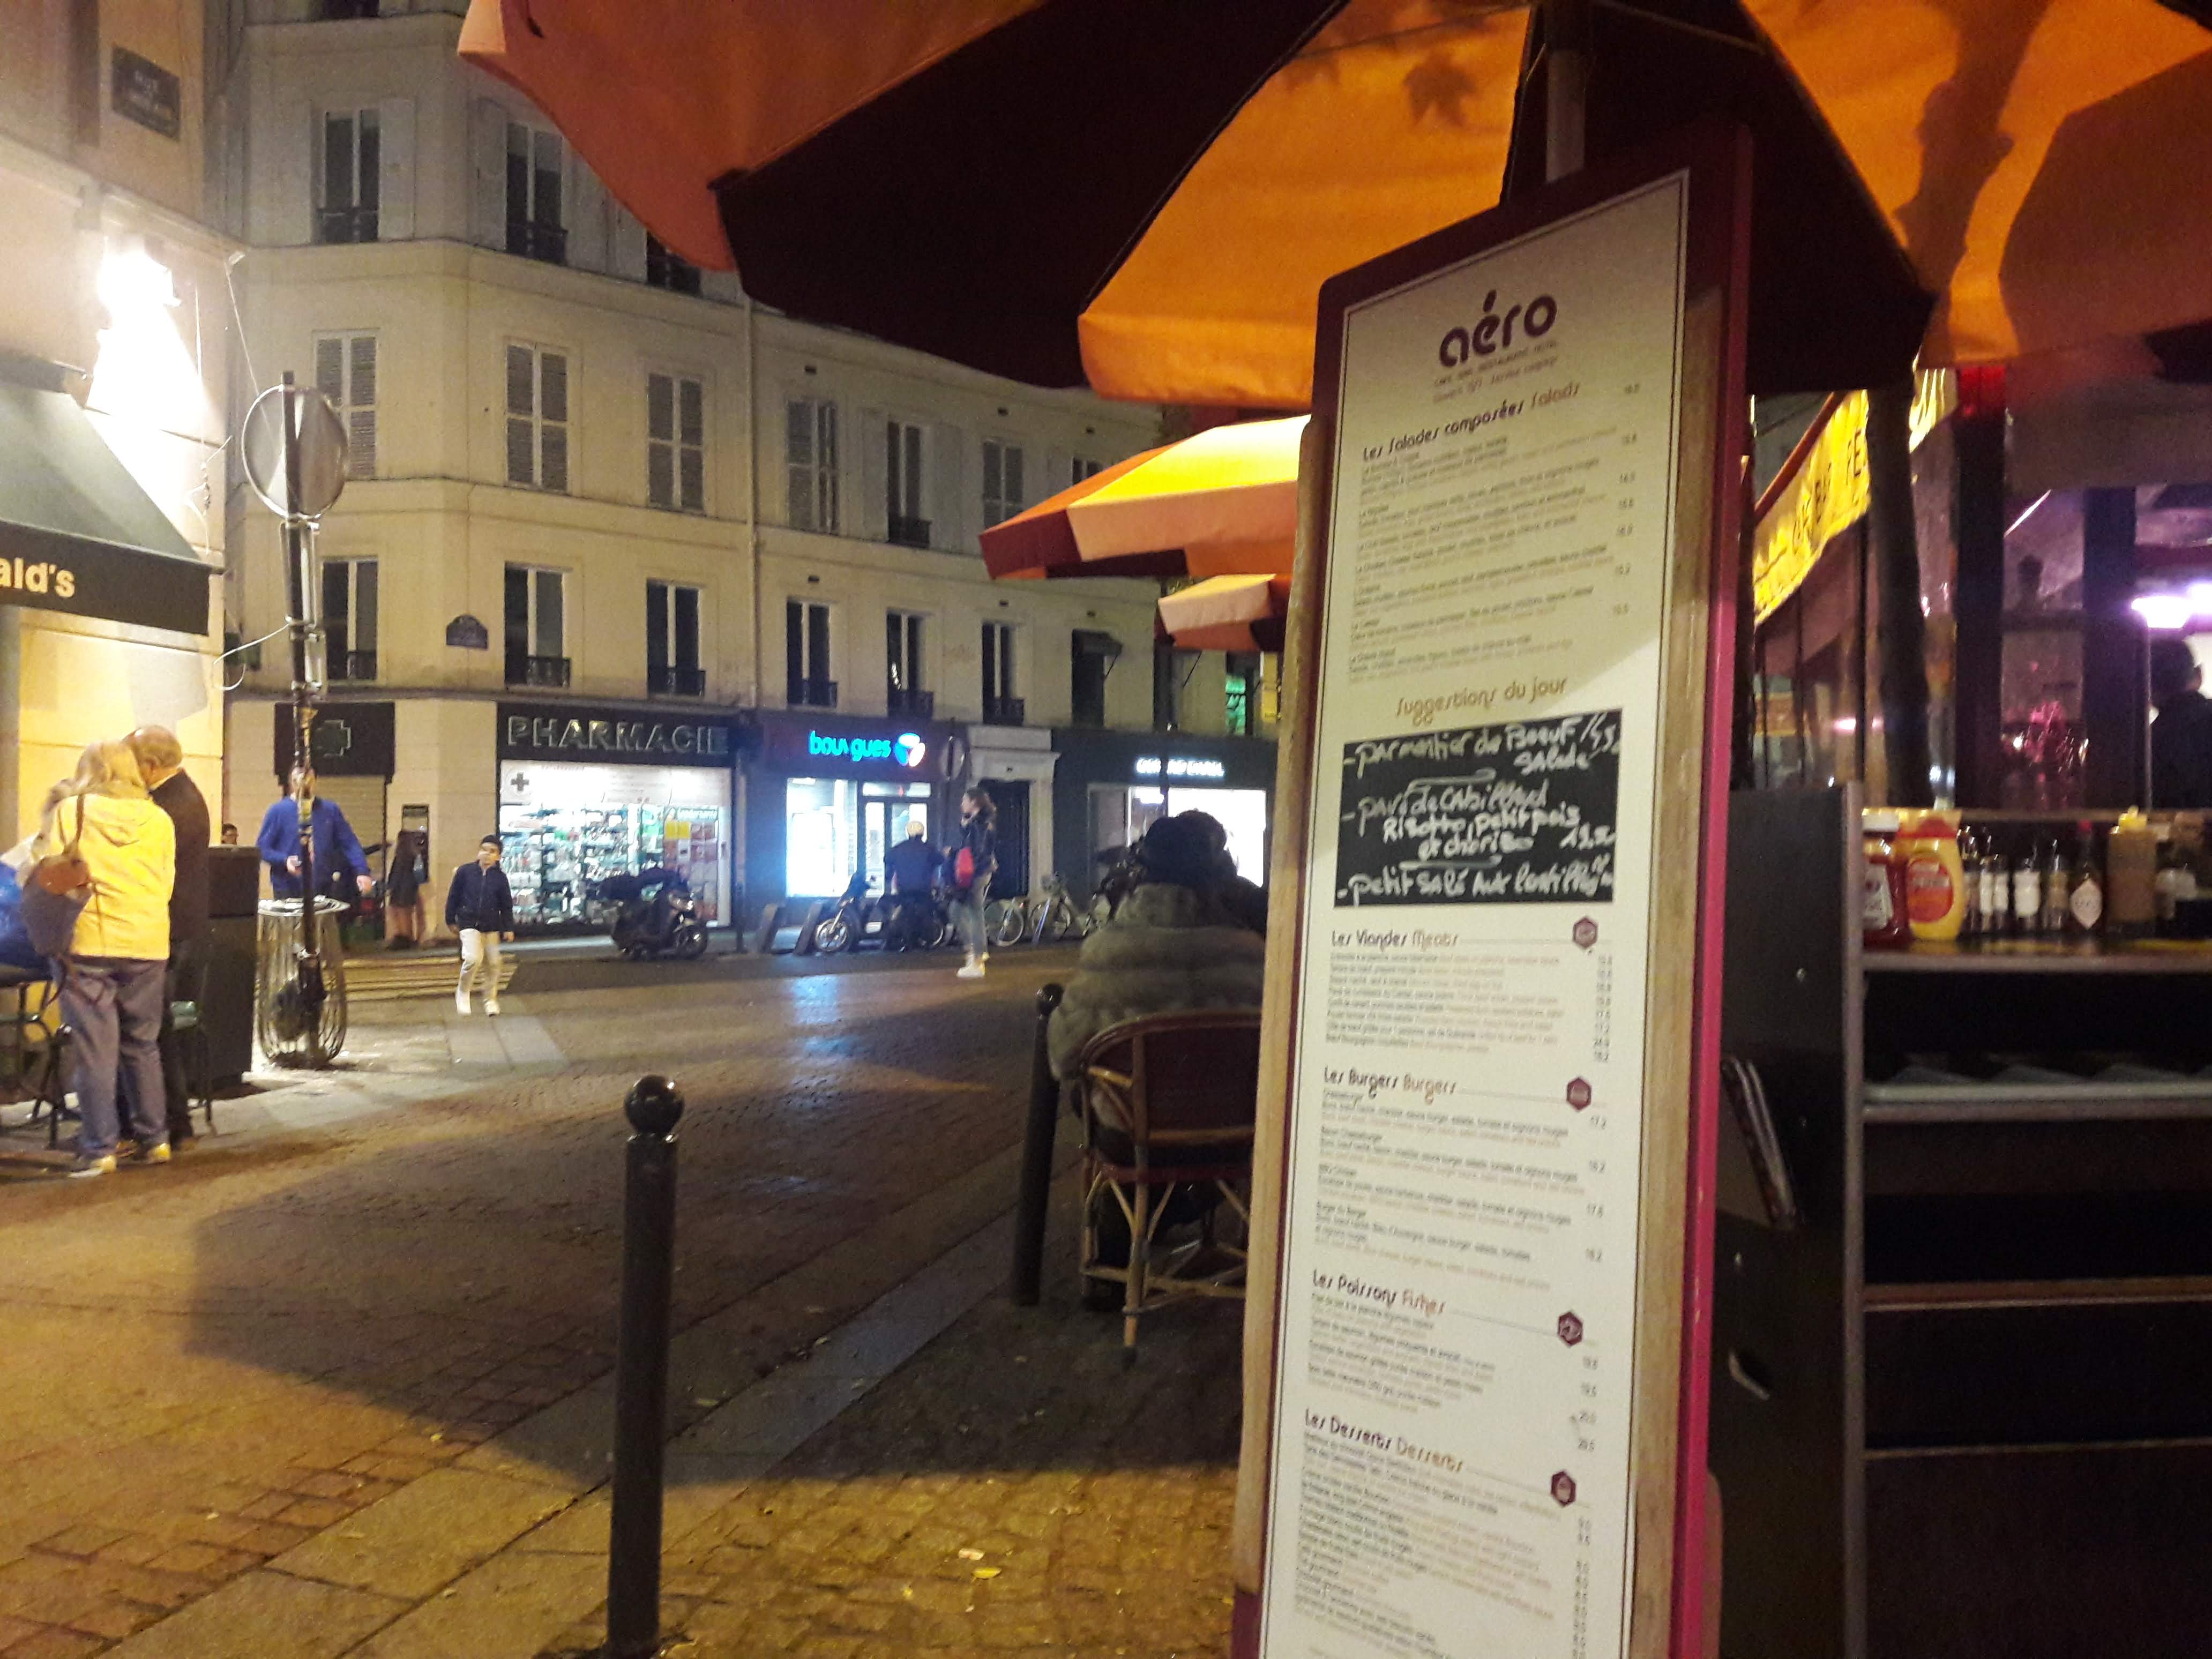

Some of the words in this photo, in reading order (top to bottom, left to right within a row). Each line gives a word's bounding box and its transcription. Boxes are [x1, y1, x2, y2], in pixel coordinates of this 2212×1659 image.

[1439, 289, 1557, 368] aéro
[1363, 445, 1382, 462] Les
[1505, 681, 1526, 700] du
[1530, 675, 1568, 703] jour
[507, 715, 729, 755] PHARMACIE
[1331, 930, 1351, 947] Les
[1324, 1065, 1344, 1085] Les
[1348, 1067, 1398, 1099] Burgers
[1313, 1268, 1333, 1289] Les
[1304, 1408, 1326, 1430] Les
[1329, 1415, 1393, 1452] Desserts
